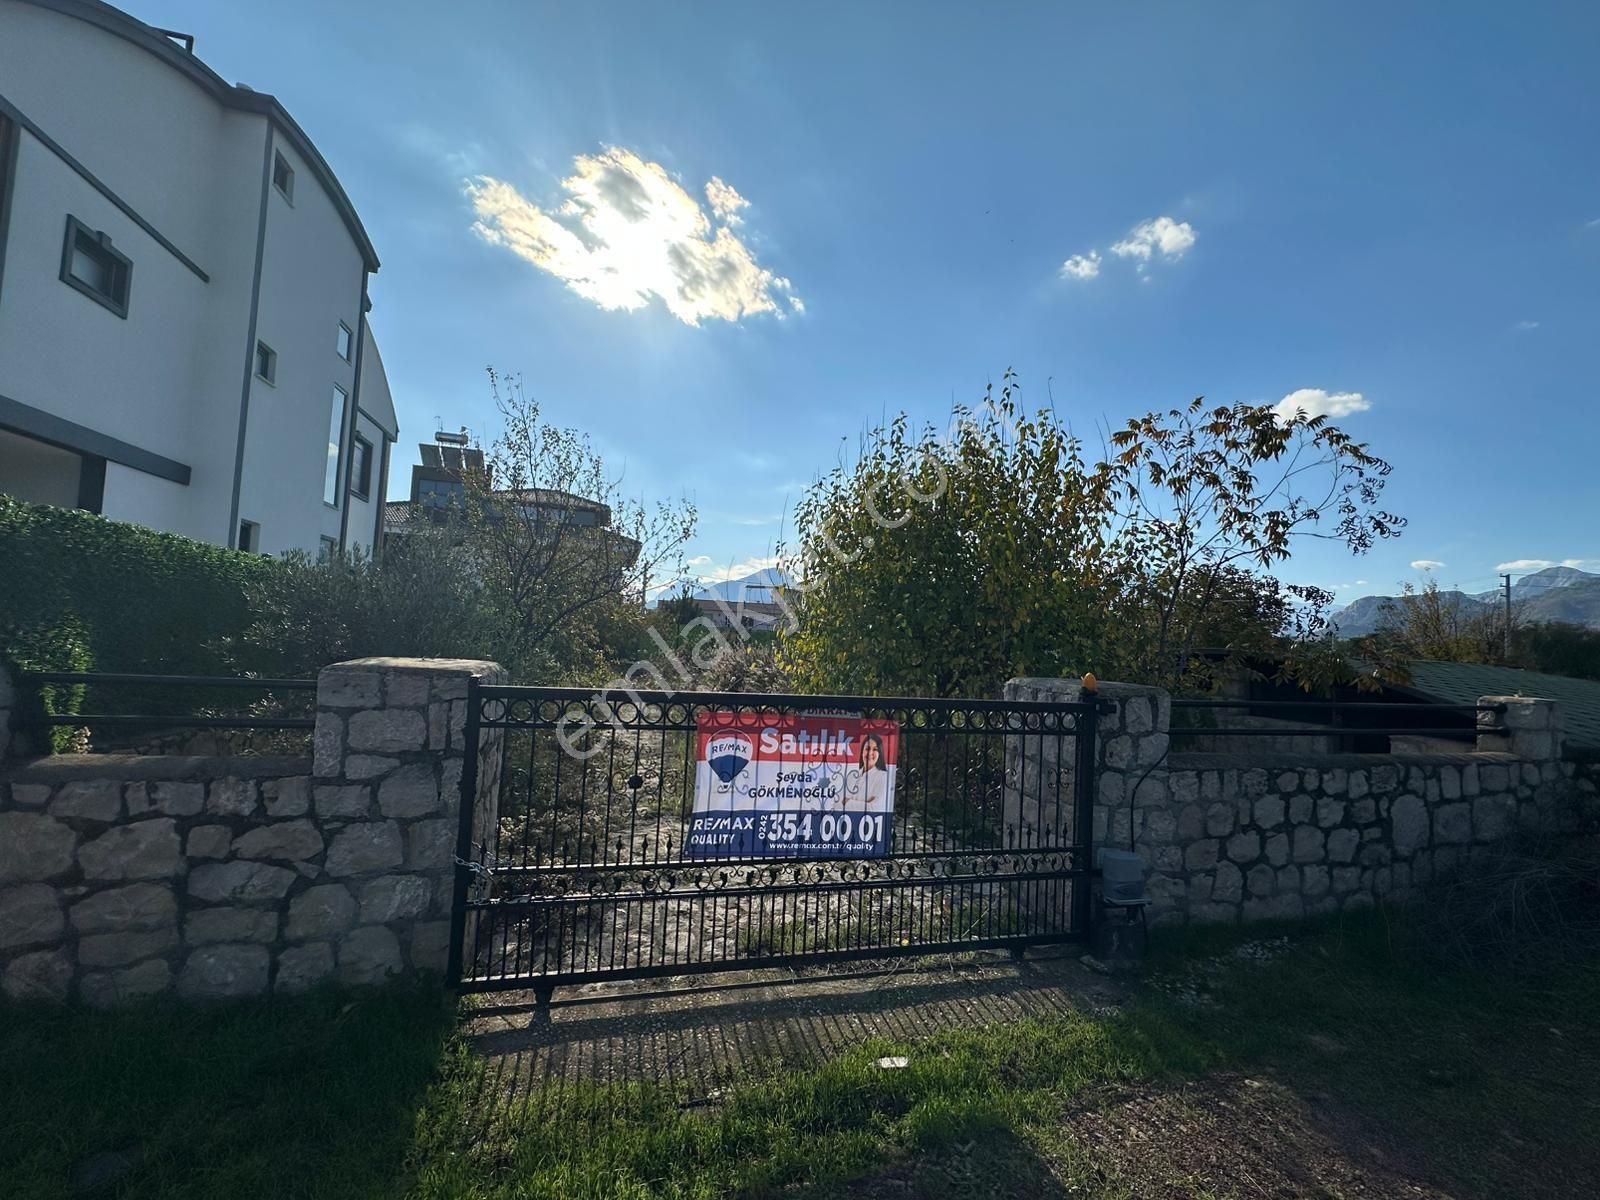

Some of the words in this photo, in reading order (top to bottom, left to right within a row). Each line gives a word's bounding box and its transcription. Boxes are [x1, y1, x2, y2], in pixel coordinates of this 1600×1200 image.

[760, 727, 854, 756] Satılık
[712, 743, 747, 754] RE/MAX
[776, 771, 812, 784] Şeyda
[748, 785, 836, 799] GÖKMENOĞLU
[693, 817, 755, 830] RE/MAX
[758, 815, 768, 839] 0242
[767, 814, 812, 841] 354
[820, 814, 852, 841] 00
[858, 814, 884, 842] 01
[690, 833, 735, 845] QUALITY
[769, 842, 874, 851] www.remax.com.tr/quality
